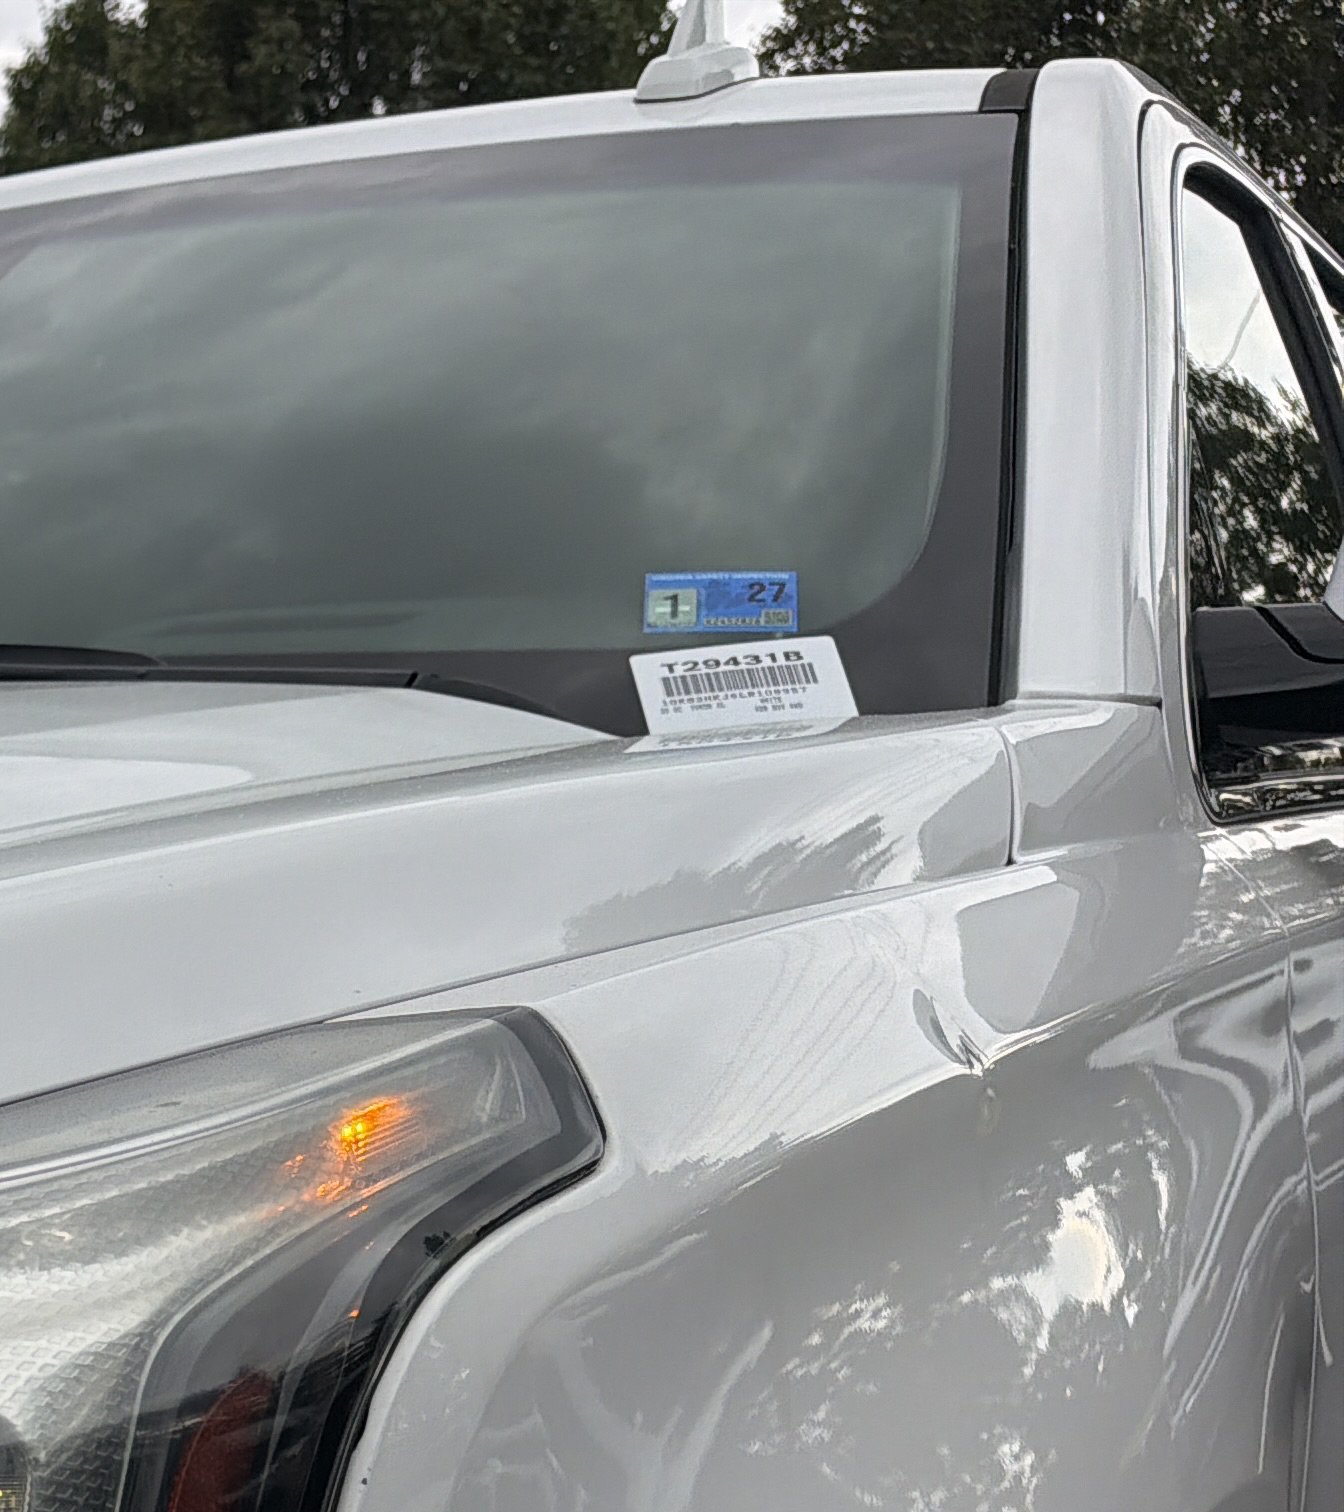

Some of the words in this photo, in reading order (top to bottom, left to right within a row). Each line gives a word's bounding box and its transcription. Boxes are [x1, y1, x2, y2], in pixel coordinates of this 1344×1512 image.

[747, 582, 787, 604] 27
[663, 593, 679, 619] 1
[660, 650, 804, 675] T29431B
